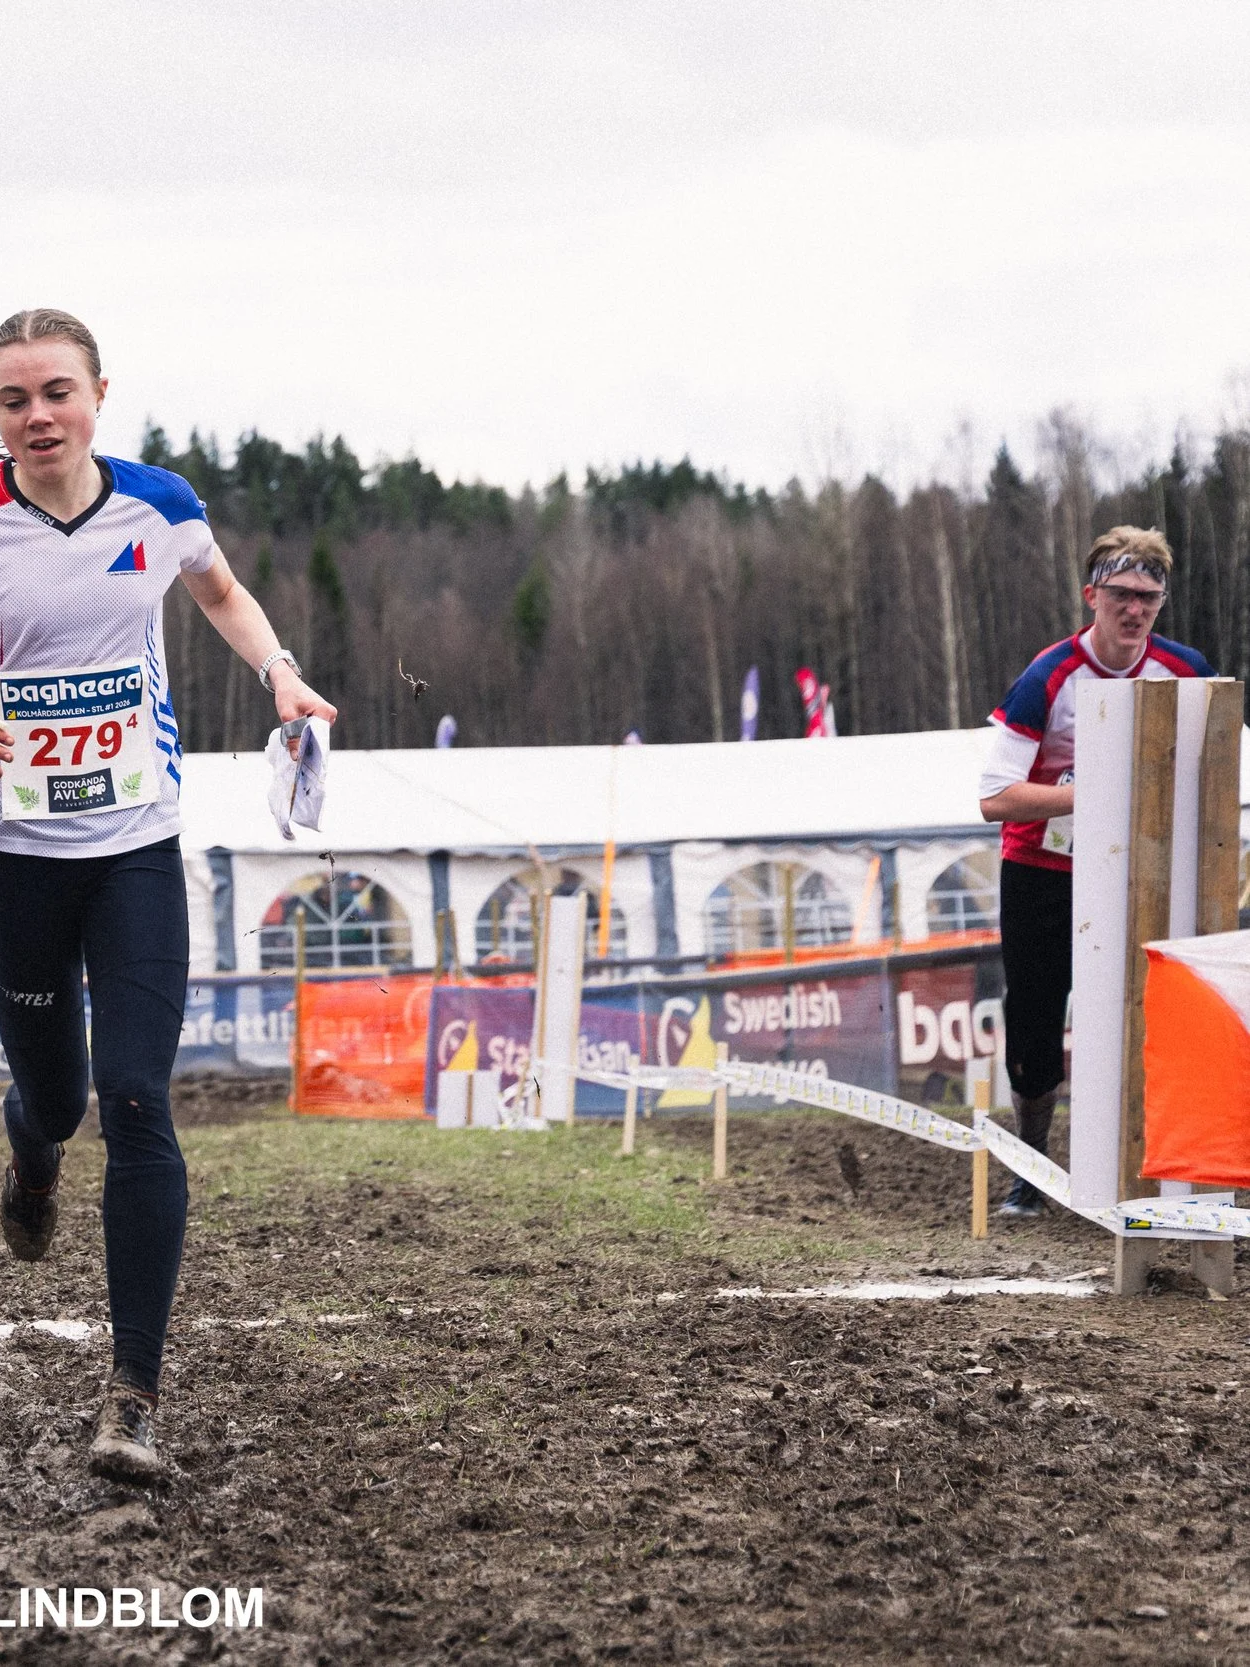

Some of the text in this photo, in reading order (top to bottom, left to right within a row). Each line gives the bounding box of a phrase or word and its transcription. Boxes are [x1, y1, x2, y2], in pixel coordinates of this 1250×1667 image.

[2, 672, 141, 706] bagheera
[16, 707, 86, 718] KOLMÅRDSKAVLEN
[91, 704, 105, 713] STL
[105, 703, 114, 711] #1
[115, 699, 131, 709] 2026
[28, 713, 138, 767] 279 4
[53, 775, 106, 789] GODKÄNDA
[723, 981, 842, 1034] Swedish
